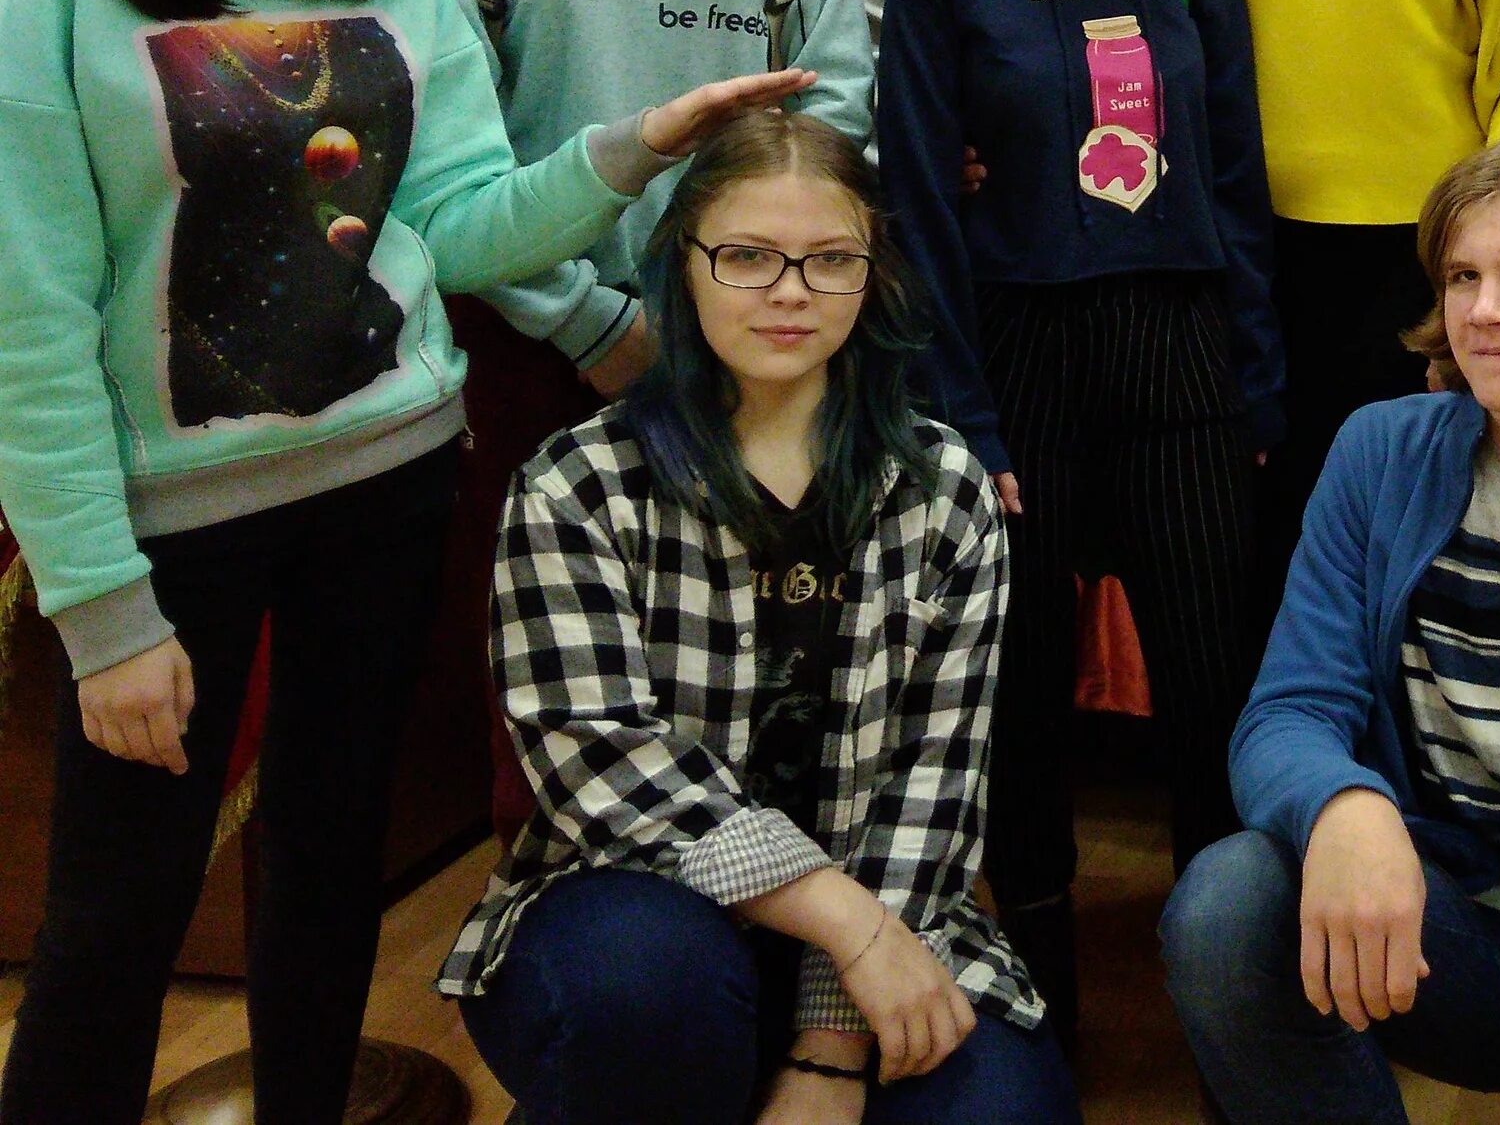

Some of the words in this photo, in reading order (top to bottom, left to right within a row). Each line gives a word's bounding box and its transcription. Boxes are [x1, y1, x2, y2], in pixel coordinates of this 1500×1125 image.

[658, 3, 698, 29] be
[1117, 81, 1143, 93] Jam
[1110, 97, 1151, 111] Sweet
